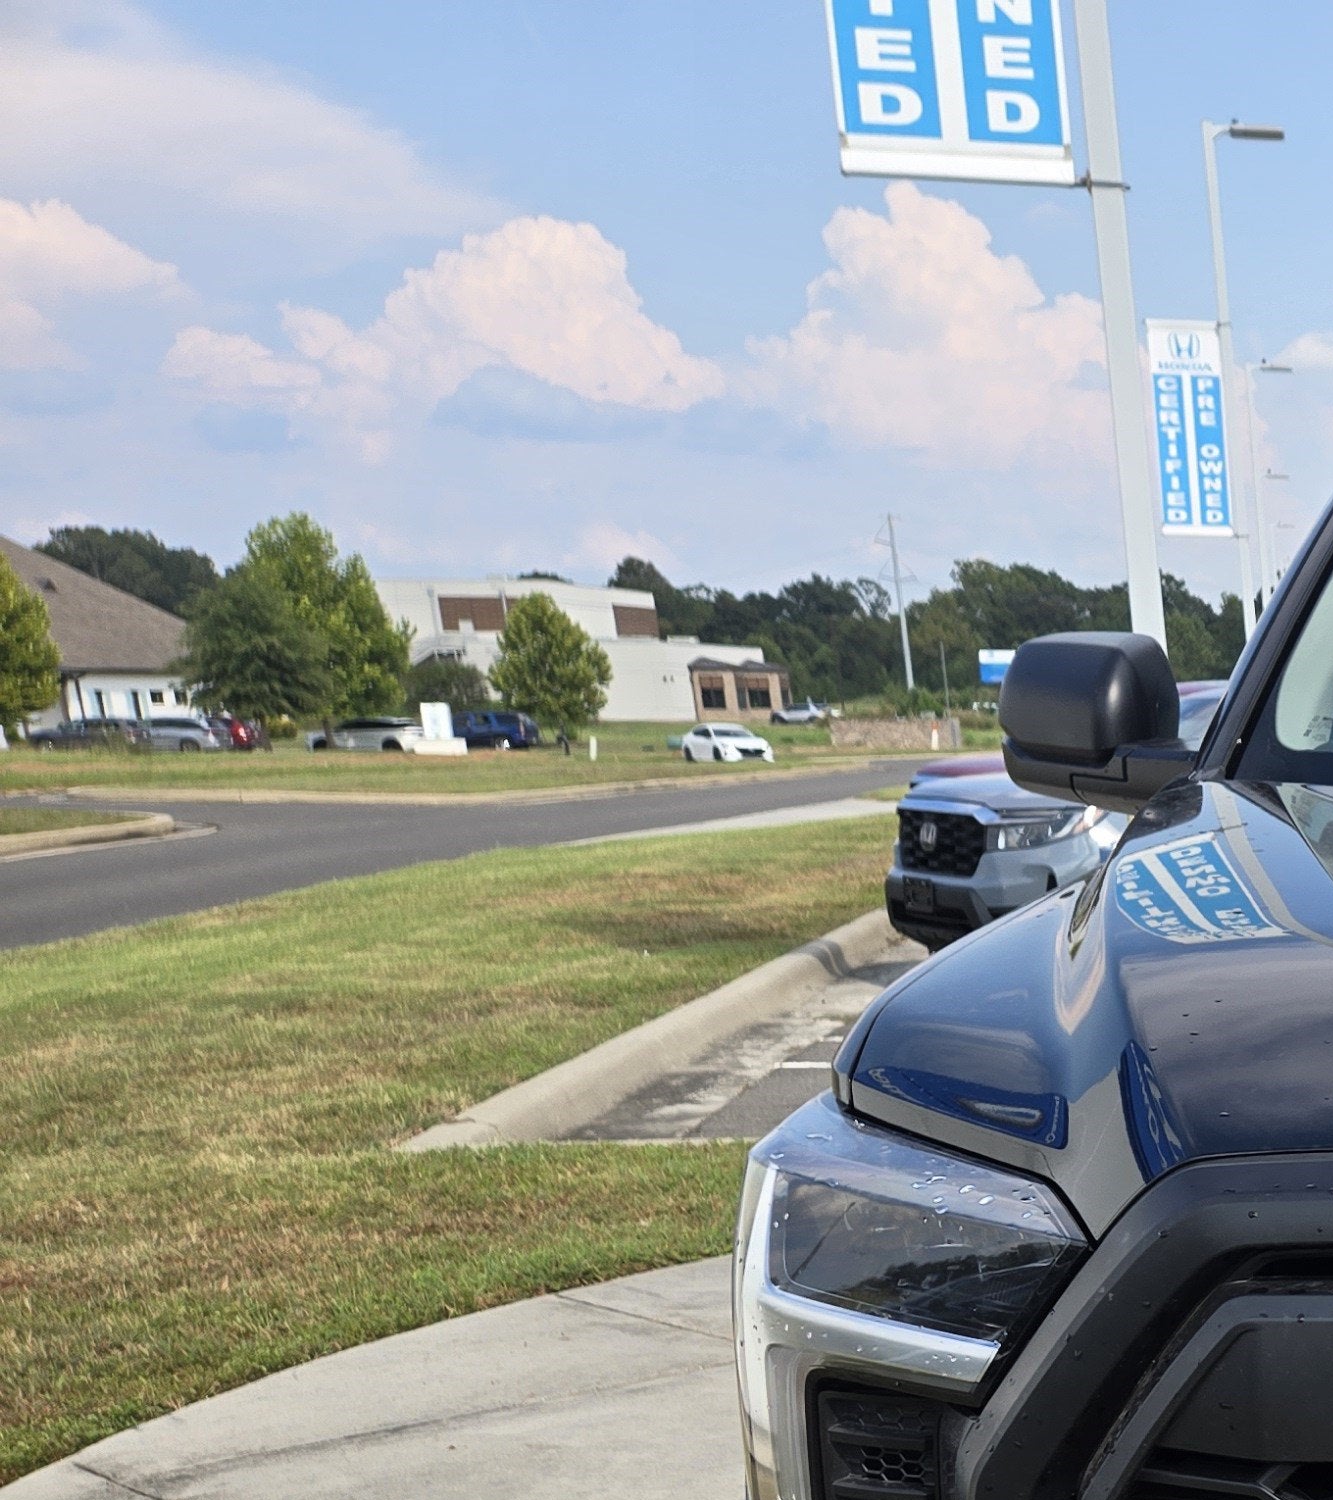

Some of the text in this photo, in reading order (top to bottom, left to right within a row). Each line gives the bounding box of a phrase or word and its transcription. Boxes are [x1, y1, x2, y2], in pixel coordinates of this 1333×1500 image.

[1156, 376, 1188, 523] CERTIFIED
[1197, 377, 1224, 523] PRE OWNED
